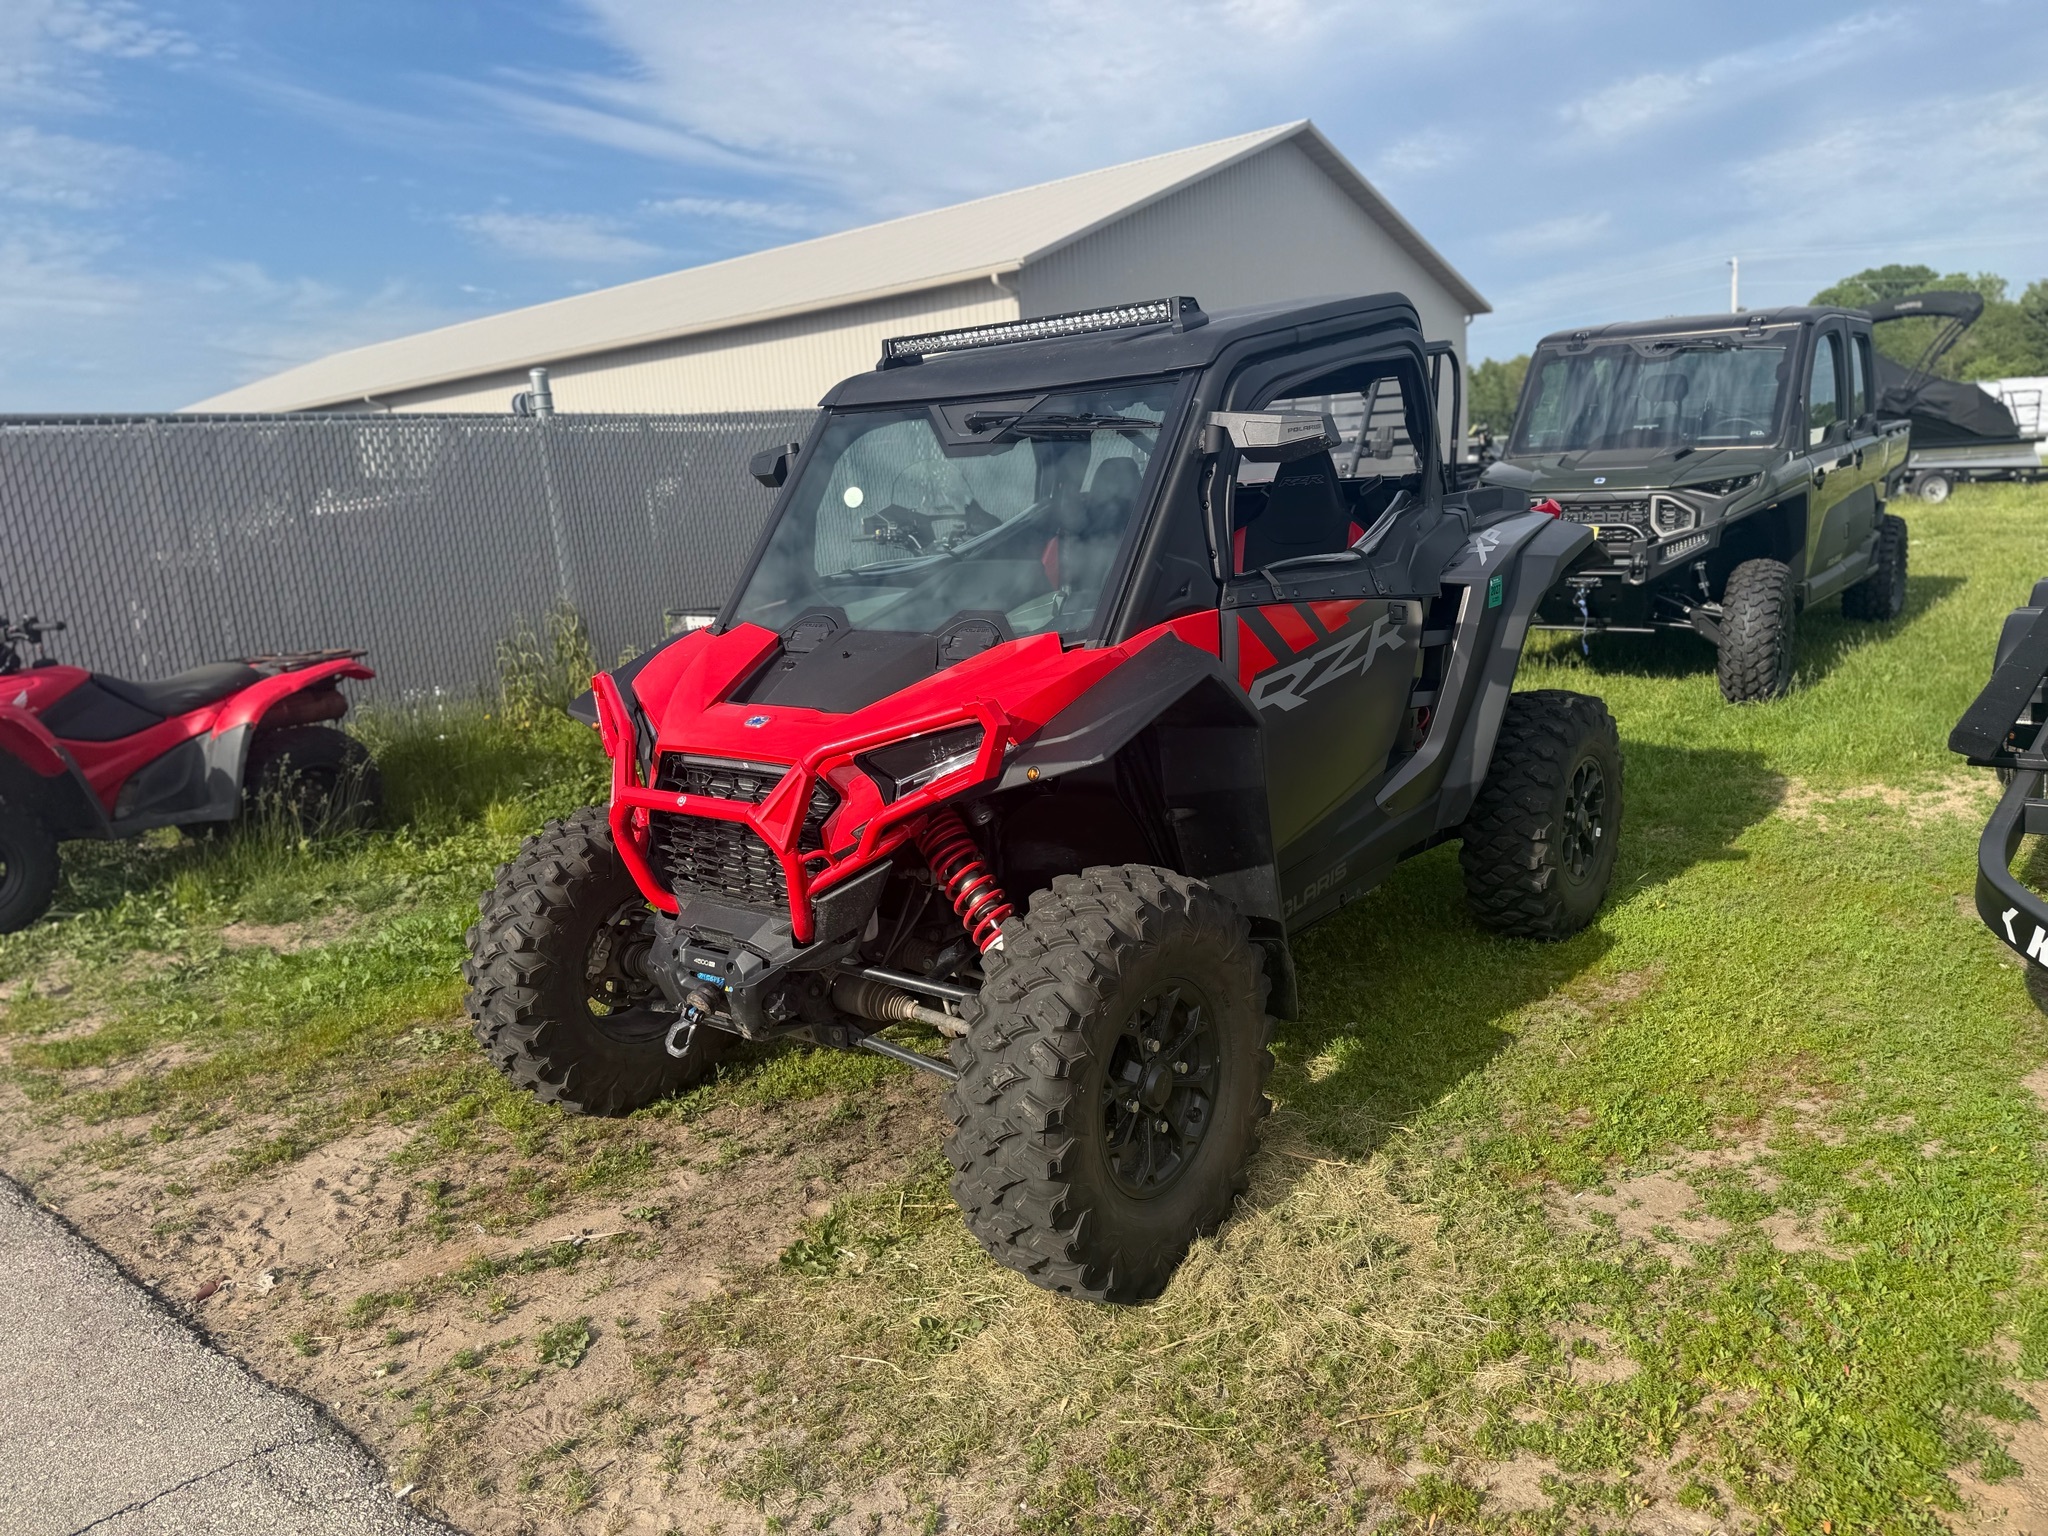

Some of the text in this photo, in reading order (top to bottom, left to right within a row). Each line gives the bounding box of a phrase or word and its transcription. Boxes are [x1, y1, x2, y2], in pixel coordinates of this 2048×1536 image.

[1287, 423, 1322, 433] POLARIS
[1279, 474, 1325, 487] RZR
[1559, 510, 1645, 523] OLARIS
[1466, 528, 1501, 566] XP
[1249, 613, 1407, 711] RZR
[1282, 861, 1347, 917] OLARIS
